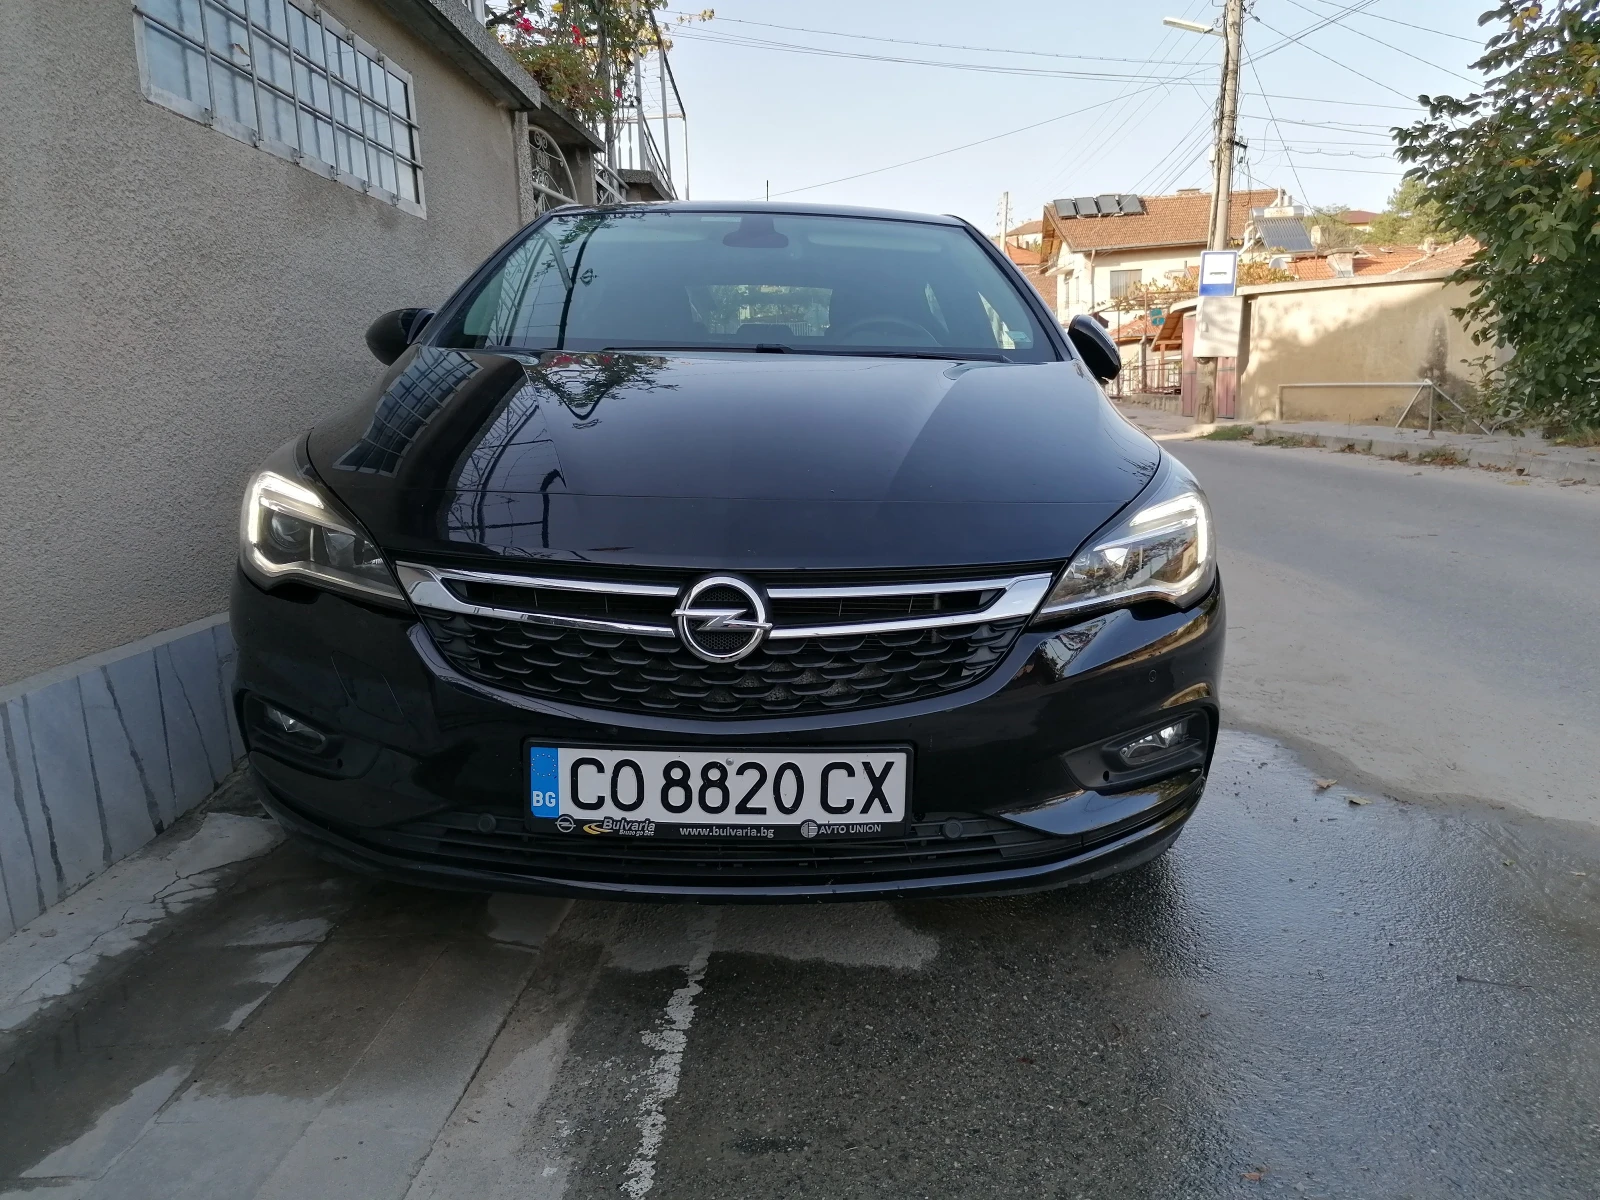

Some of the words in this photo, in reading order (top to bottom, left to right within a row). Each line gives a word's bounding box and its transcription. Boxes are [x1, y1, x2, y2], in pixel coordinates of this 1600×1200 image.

[570, 757, 645, 812] CO
[660, 760, 805, 815] 8820
[820, 761, 895, 815] CX
[532, 790, 556, 807] BG
[602, 818, 656, 831] Bulvaria
[819, 825, 847, 834] AVTO
[849, 824, 882, 833] UNION
[680, 826, 775, 839] www.bulvaria.bg
